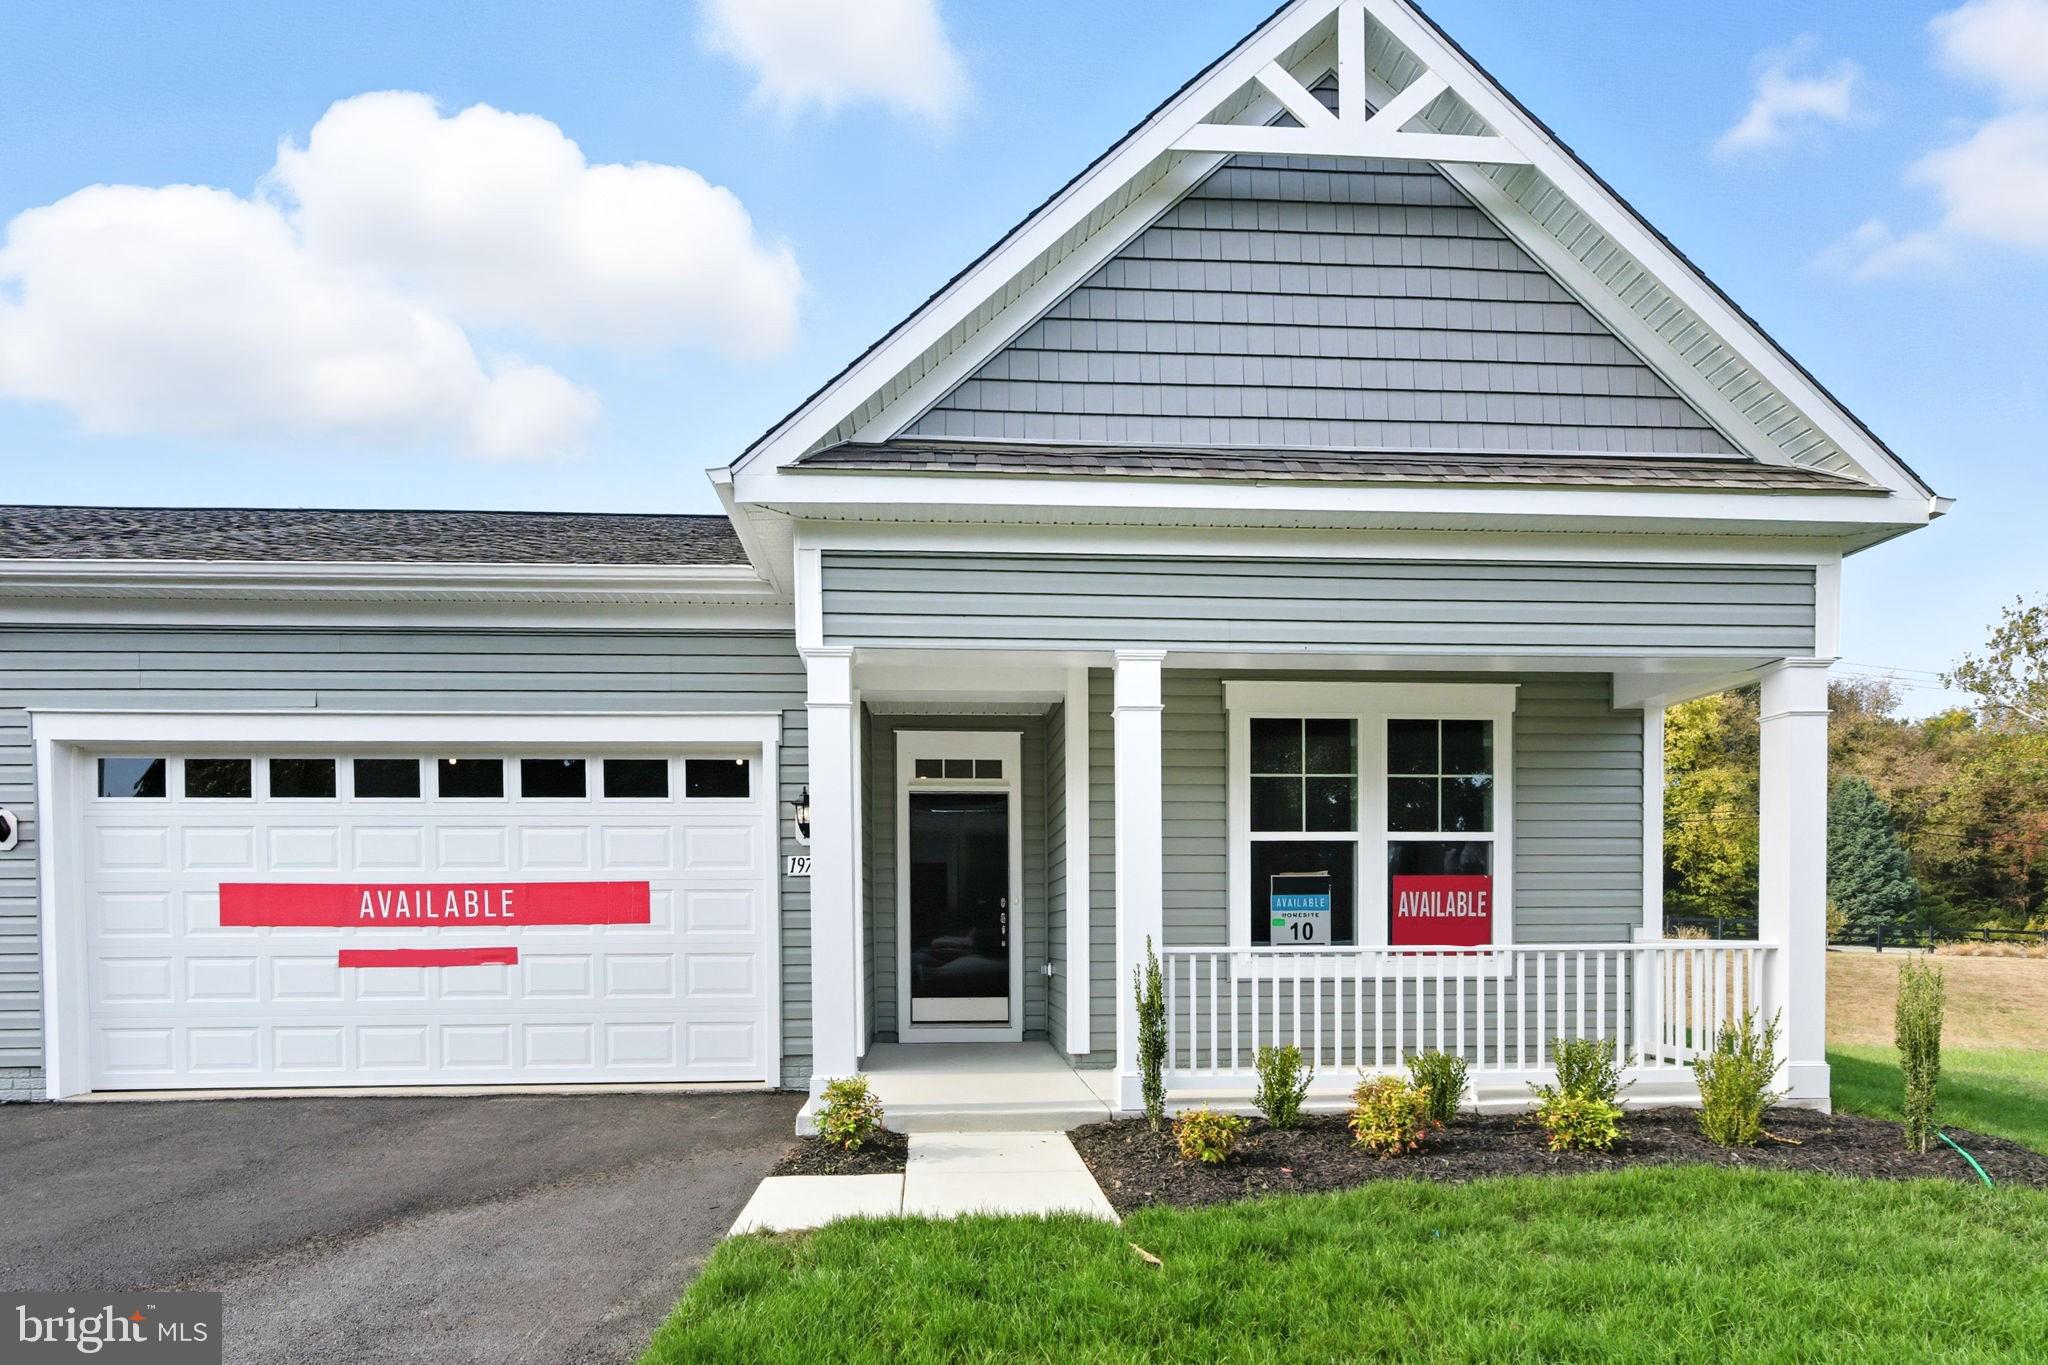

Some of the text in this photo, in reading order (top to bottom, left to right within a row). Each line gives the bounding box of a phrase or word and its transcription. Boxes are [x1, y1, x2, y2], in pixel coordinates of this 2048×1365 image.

[360, 889, 515, 918] AVAILABLE
[1276, 897, 1326, 908] AVAILABLE
[1398, 891, 1487, 917] AVAILABLE
[1290, 922, 1314, 941] 10
